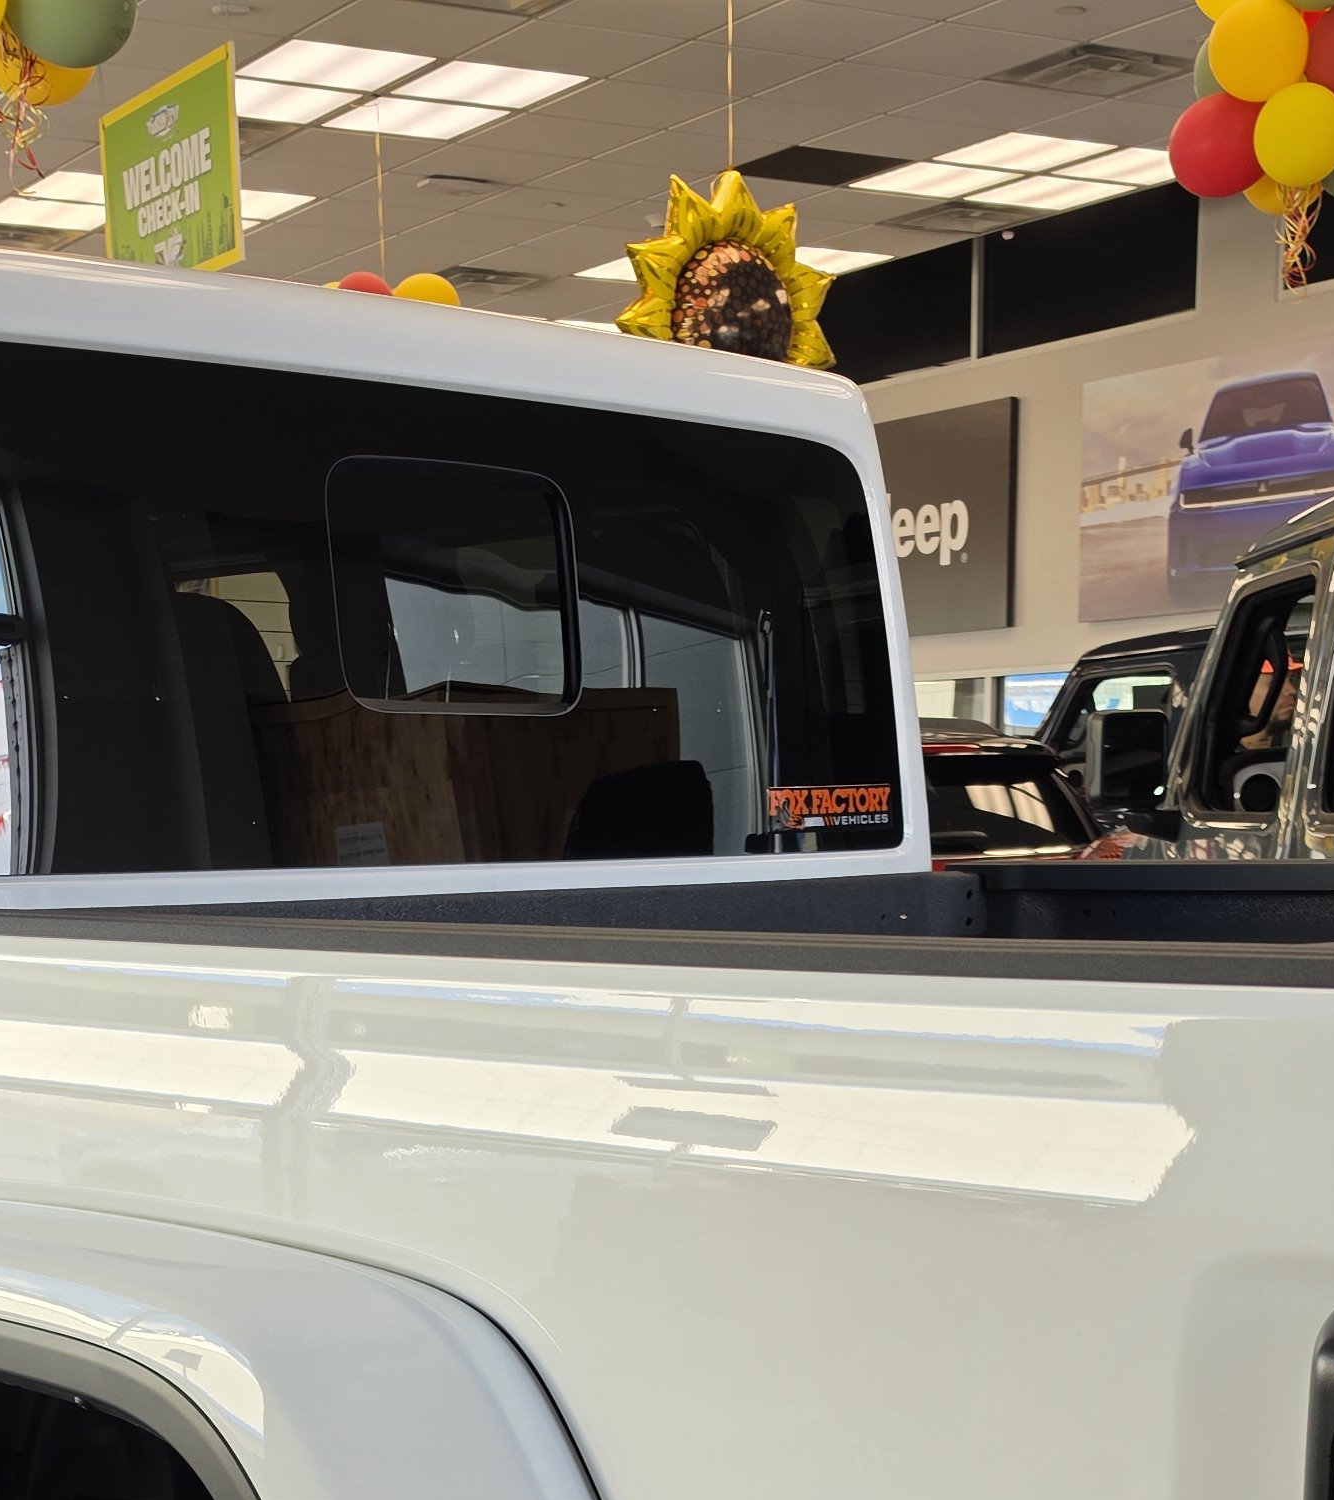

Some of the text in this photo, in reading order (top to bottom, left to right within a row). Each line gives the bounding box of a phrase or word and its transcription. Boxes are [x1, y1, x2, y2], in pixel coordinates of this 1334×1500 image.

[122, 127, 212, 211] WELCOME
[137, 180, 201, 238] CHECK-IN
[768, 786, 892, 817] FOX FACTORY
[833, 813, 889, 826] VEHICLES
